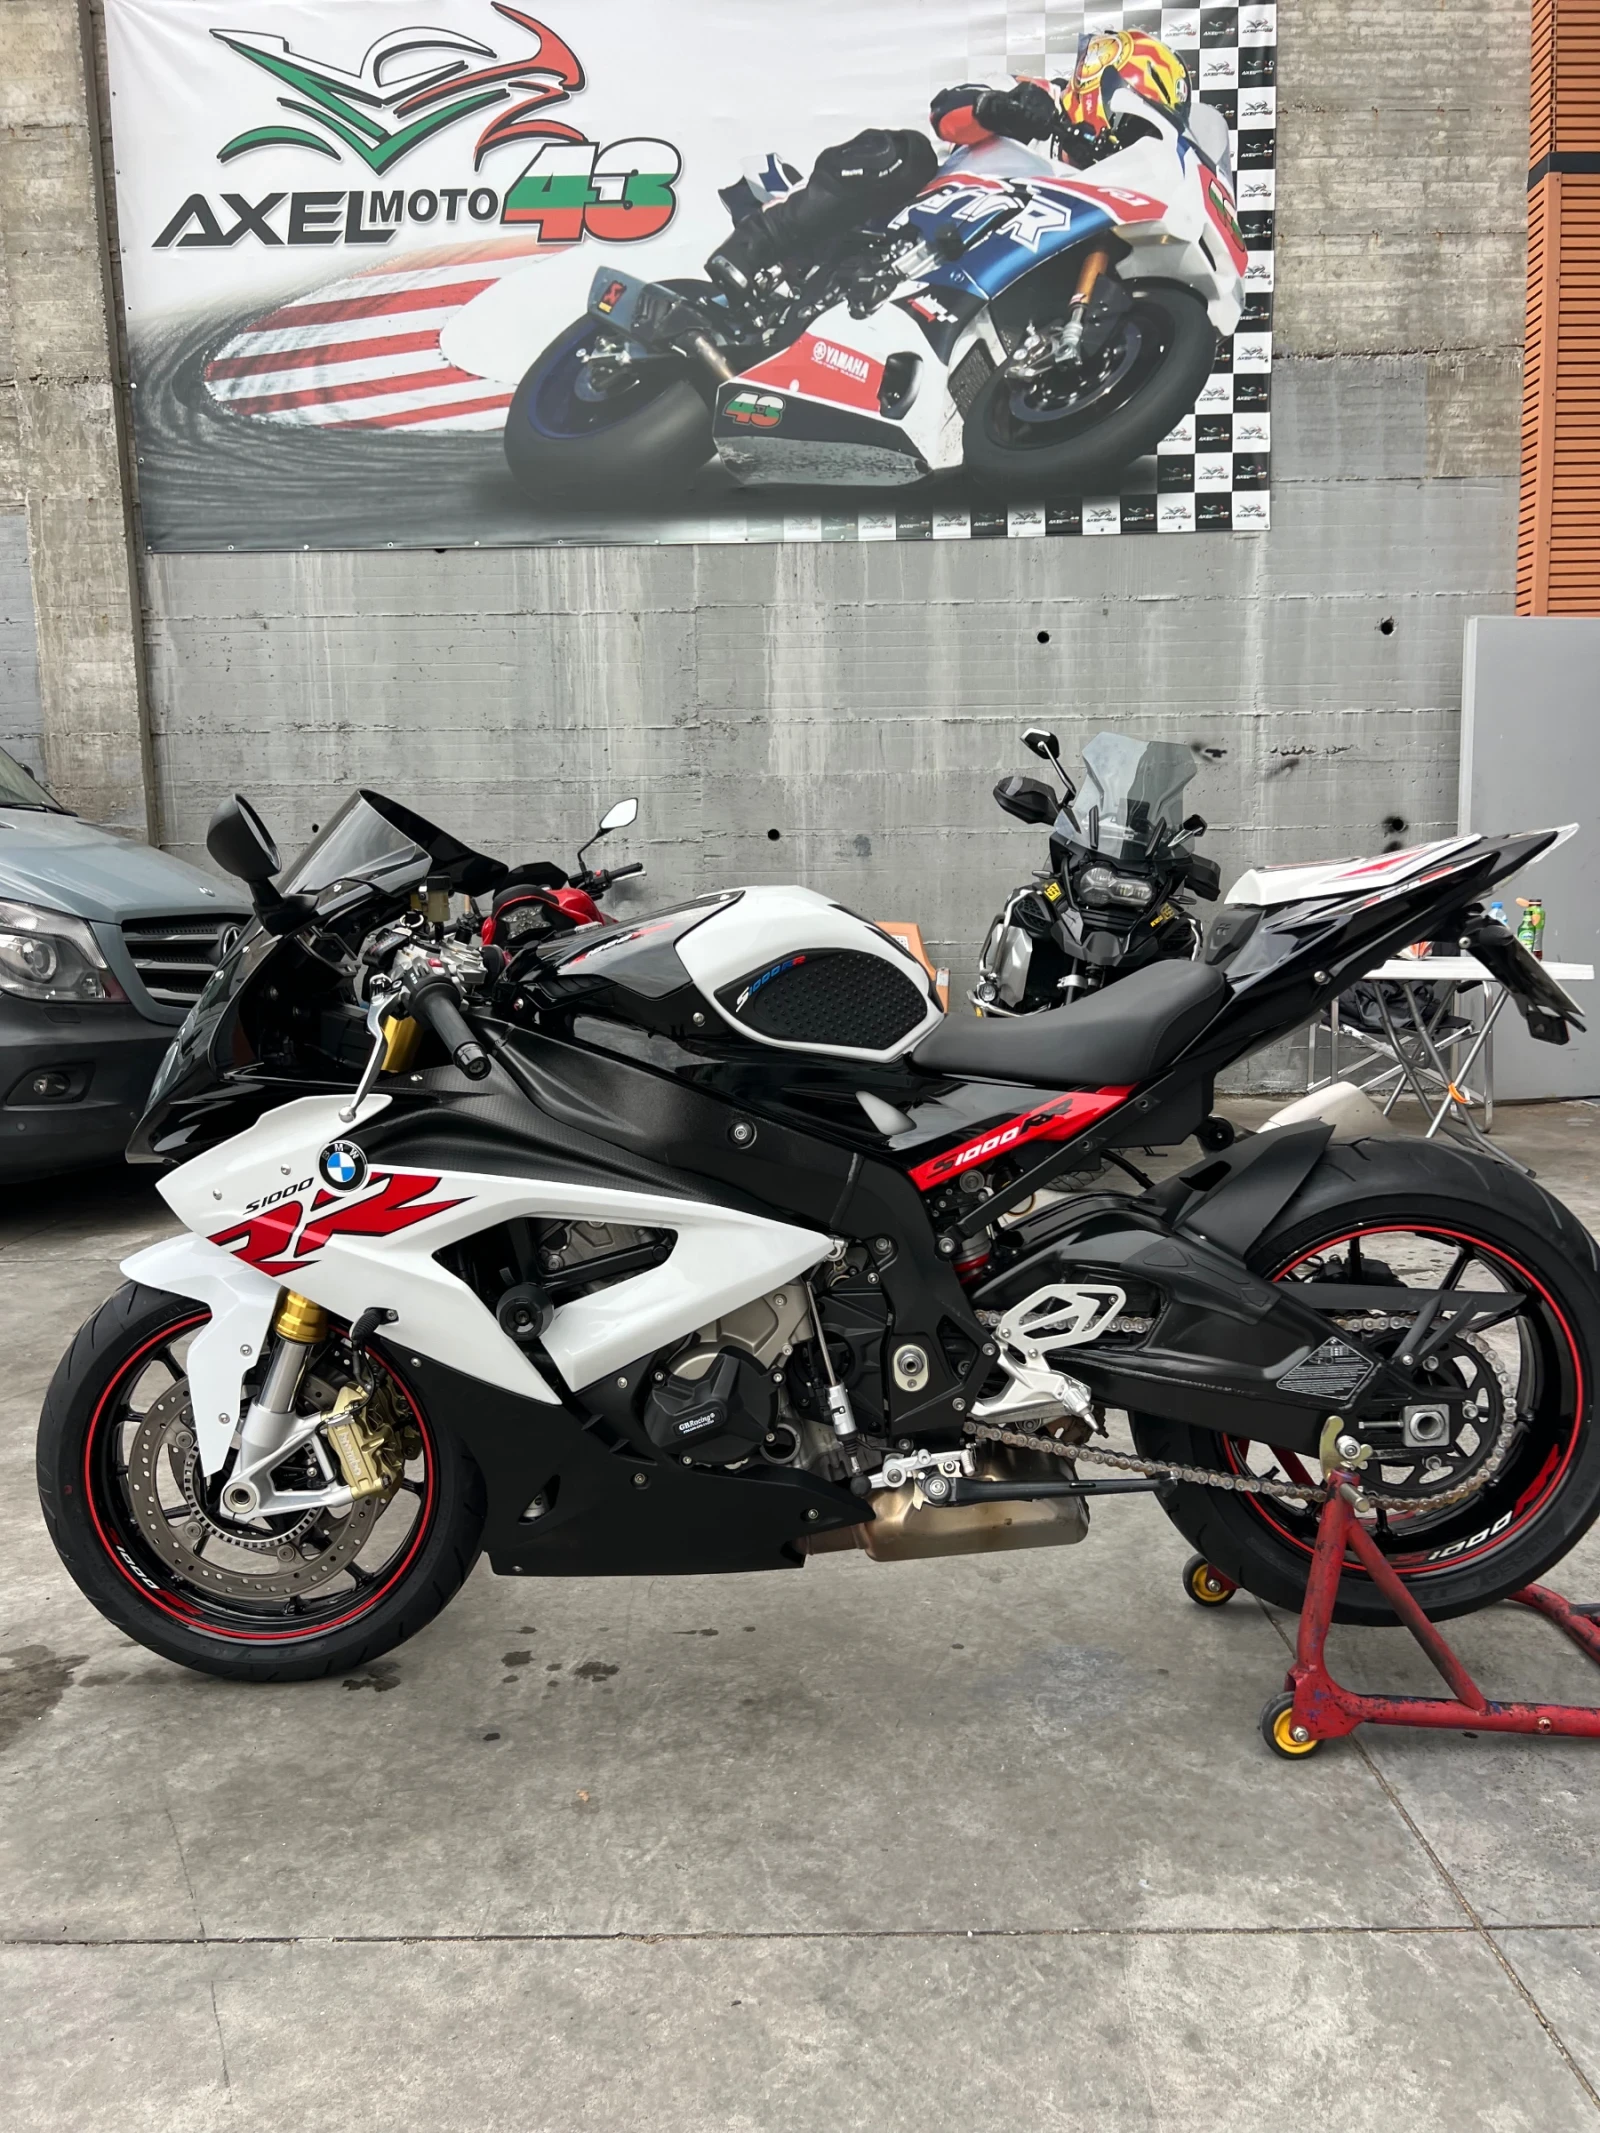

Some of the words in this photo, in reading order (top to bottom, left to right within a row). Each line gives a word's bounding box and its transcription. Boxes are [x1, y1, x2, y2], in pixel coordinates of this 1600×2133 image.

[501, 137, 682, 243] 43
[825, 345, 870, 379] YAMAHA
[722, 390, 786, 429] 43
[321, 1143, 360, 1161] BMW
[243, 1177, 314, 1215] S1000
[338, 1432, 362, 1476] brembo
